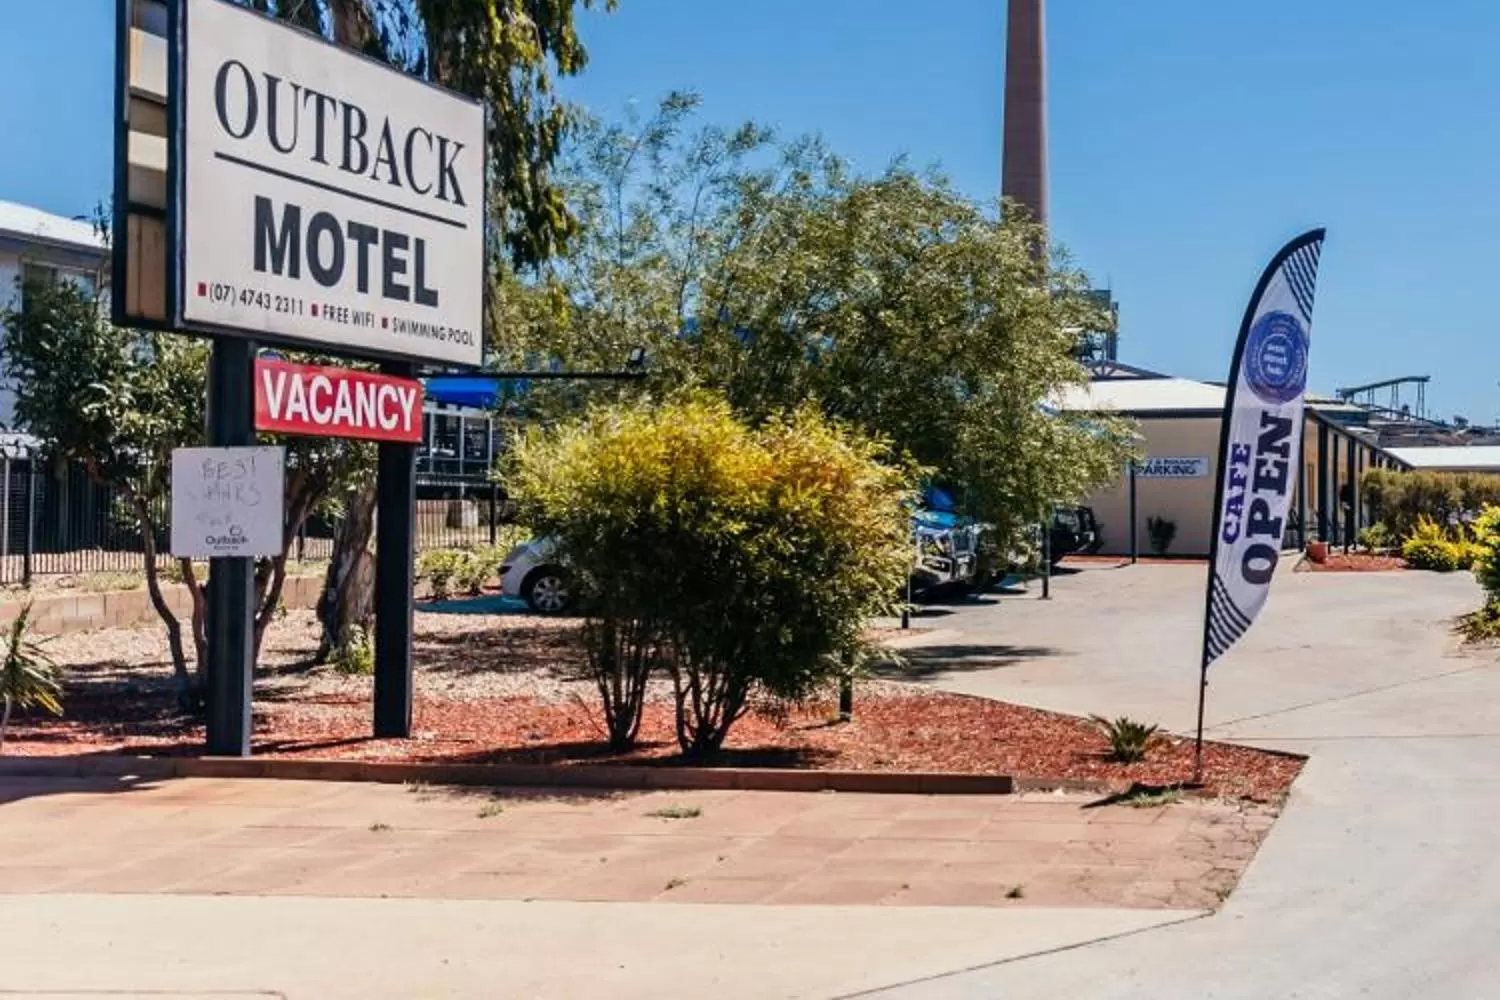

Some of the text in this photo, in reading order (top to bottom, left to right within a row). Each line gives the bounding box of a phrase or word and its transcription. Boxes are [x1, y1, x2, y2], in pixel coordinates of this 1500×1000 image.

[215, 59, 467, 206] OUTBACK
[253, 194, 439, 307] MOTEL
[209, 283, 475, 346] (07) 4743 2311 FREE WIFI SWIMMING POOL
[262, 368, 417, 432] VACANCY
[1221, 443, 1252, 545] CAFE
[1241, 410, 1294, 585] OPEN
